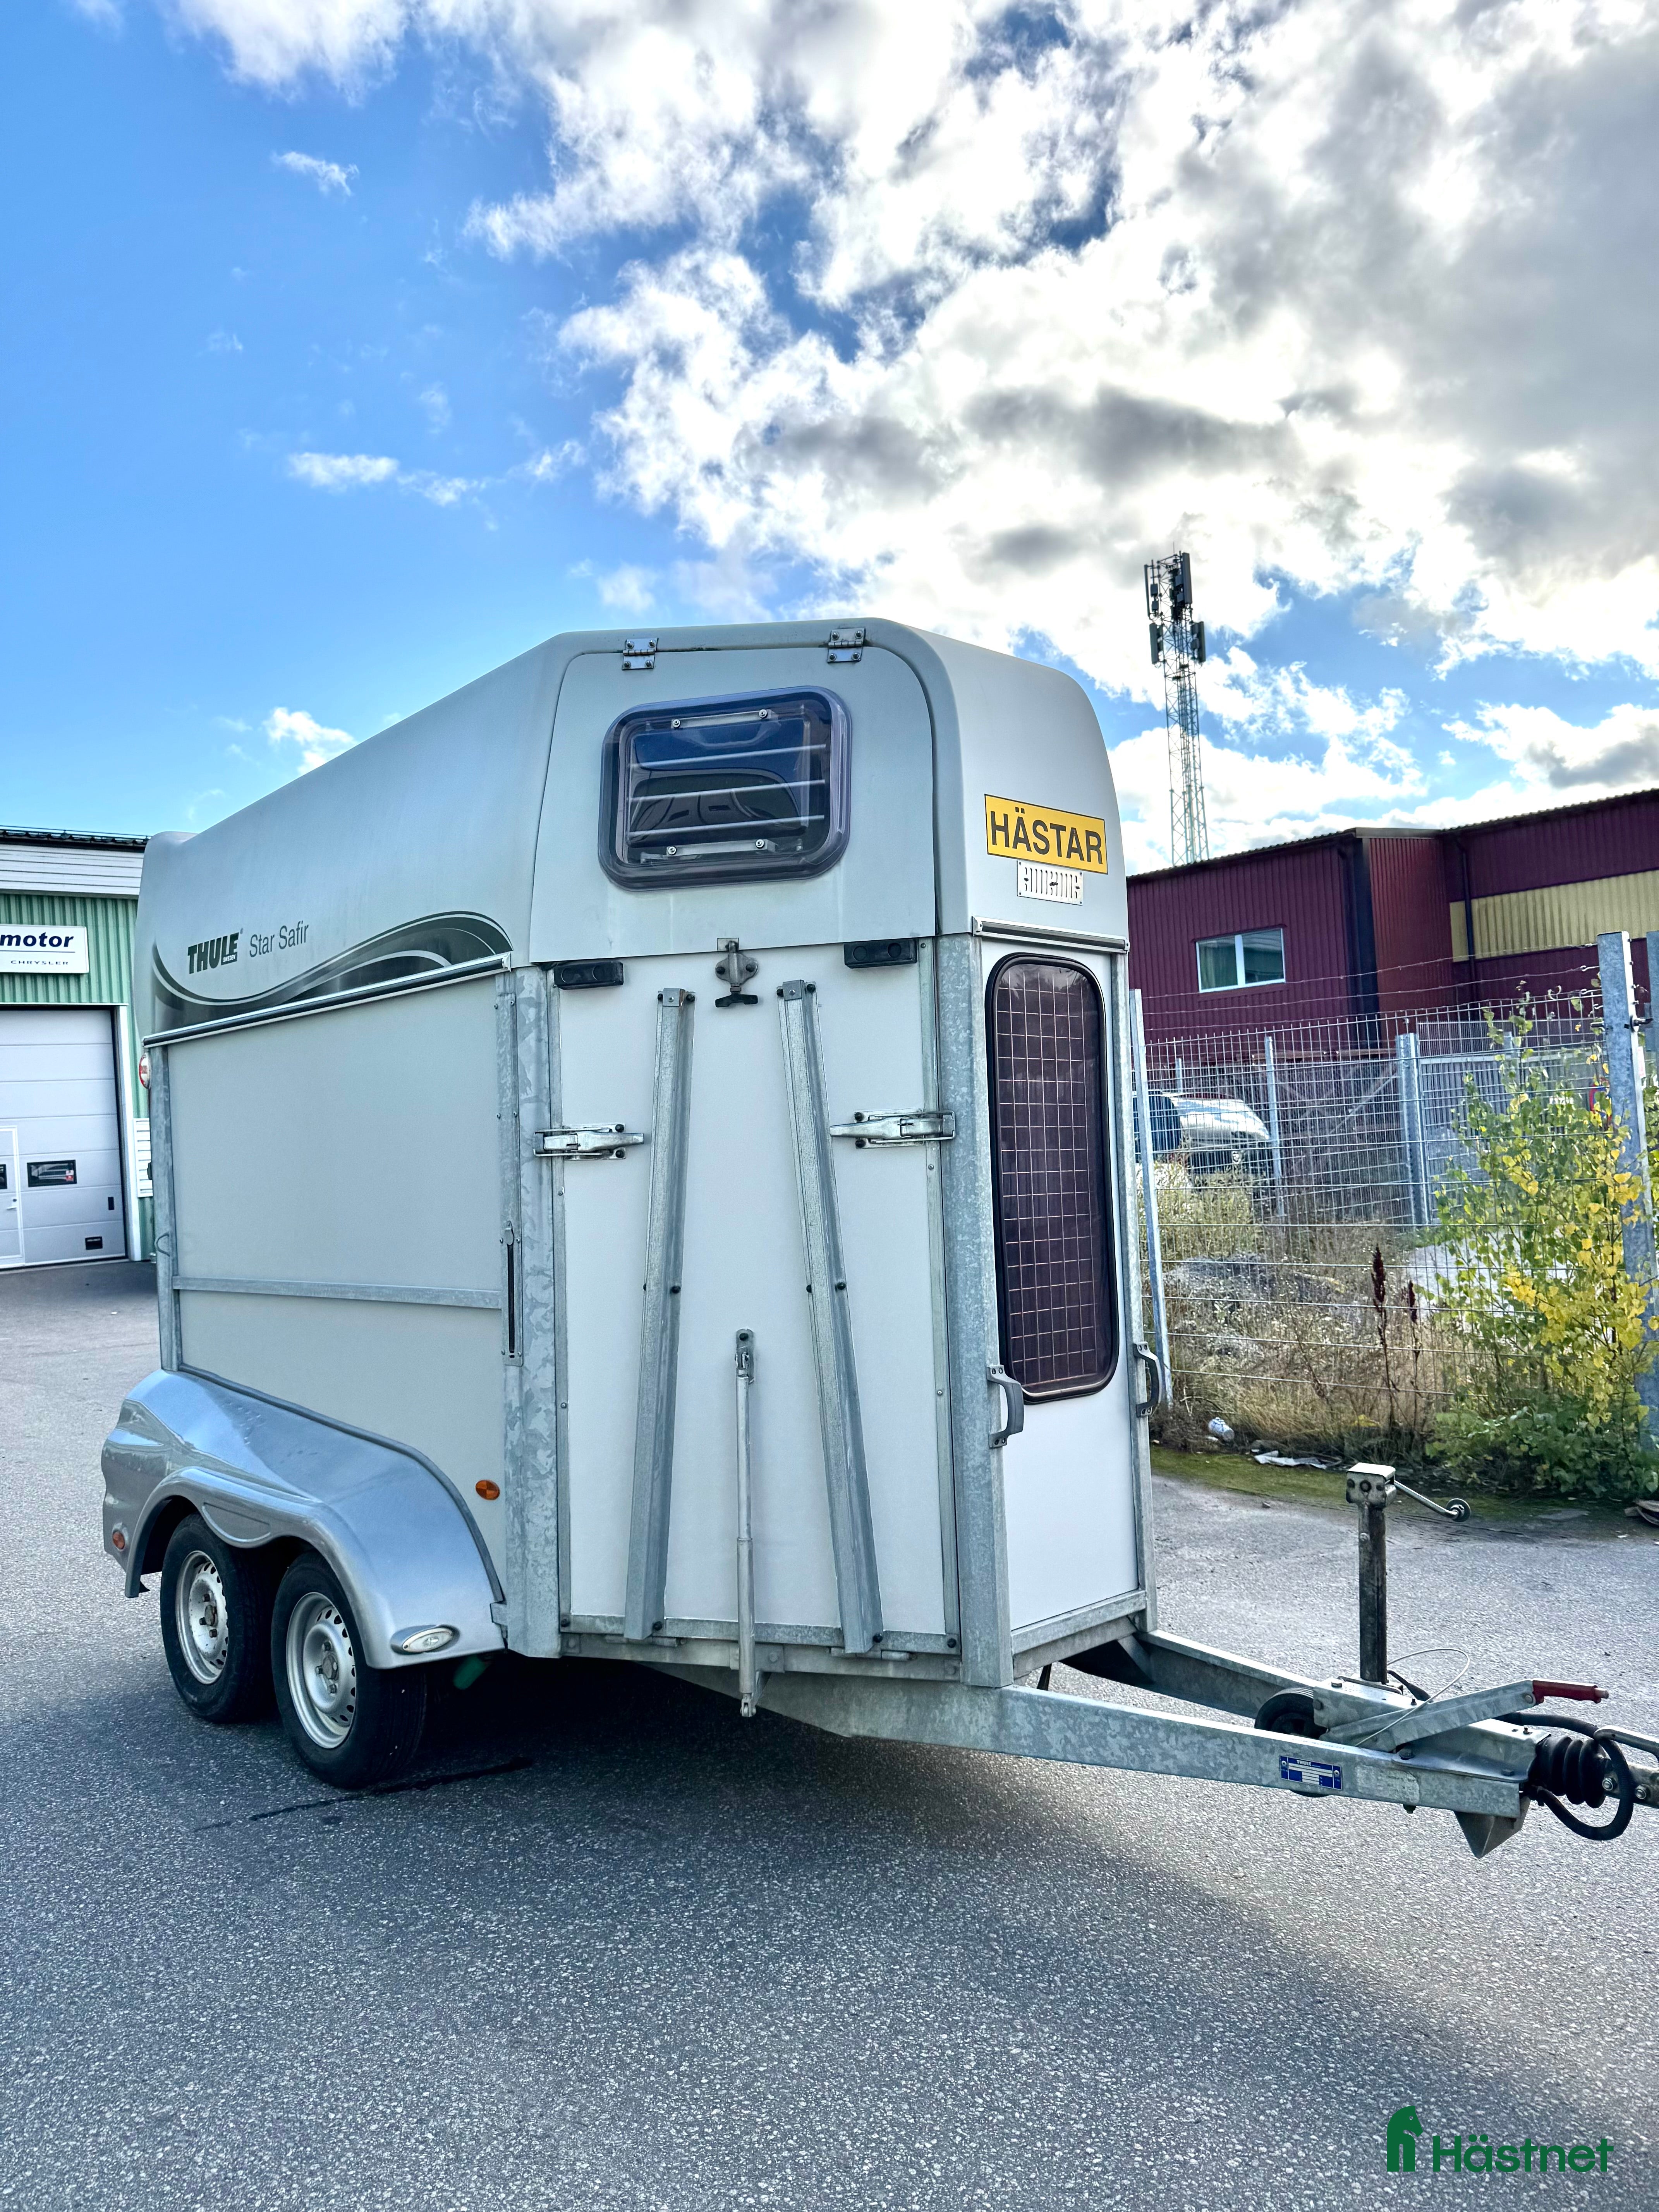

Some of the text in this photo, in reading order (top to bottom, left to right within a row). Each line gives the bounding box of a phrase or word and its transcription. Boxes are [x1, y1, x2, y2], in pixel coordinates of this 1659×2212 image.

[990, 807, 1103, 865] HÄSTAR
[0, 932, 74, 947] motor
[188, 920, 309, 974] THULE Star Safir
[223, 954, 236, 962] SWEDEN
